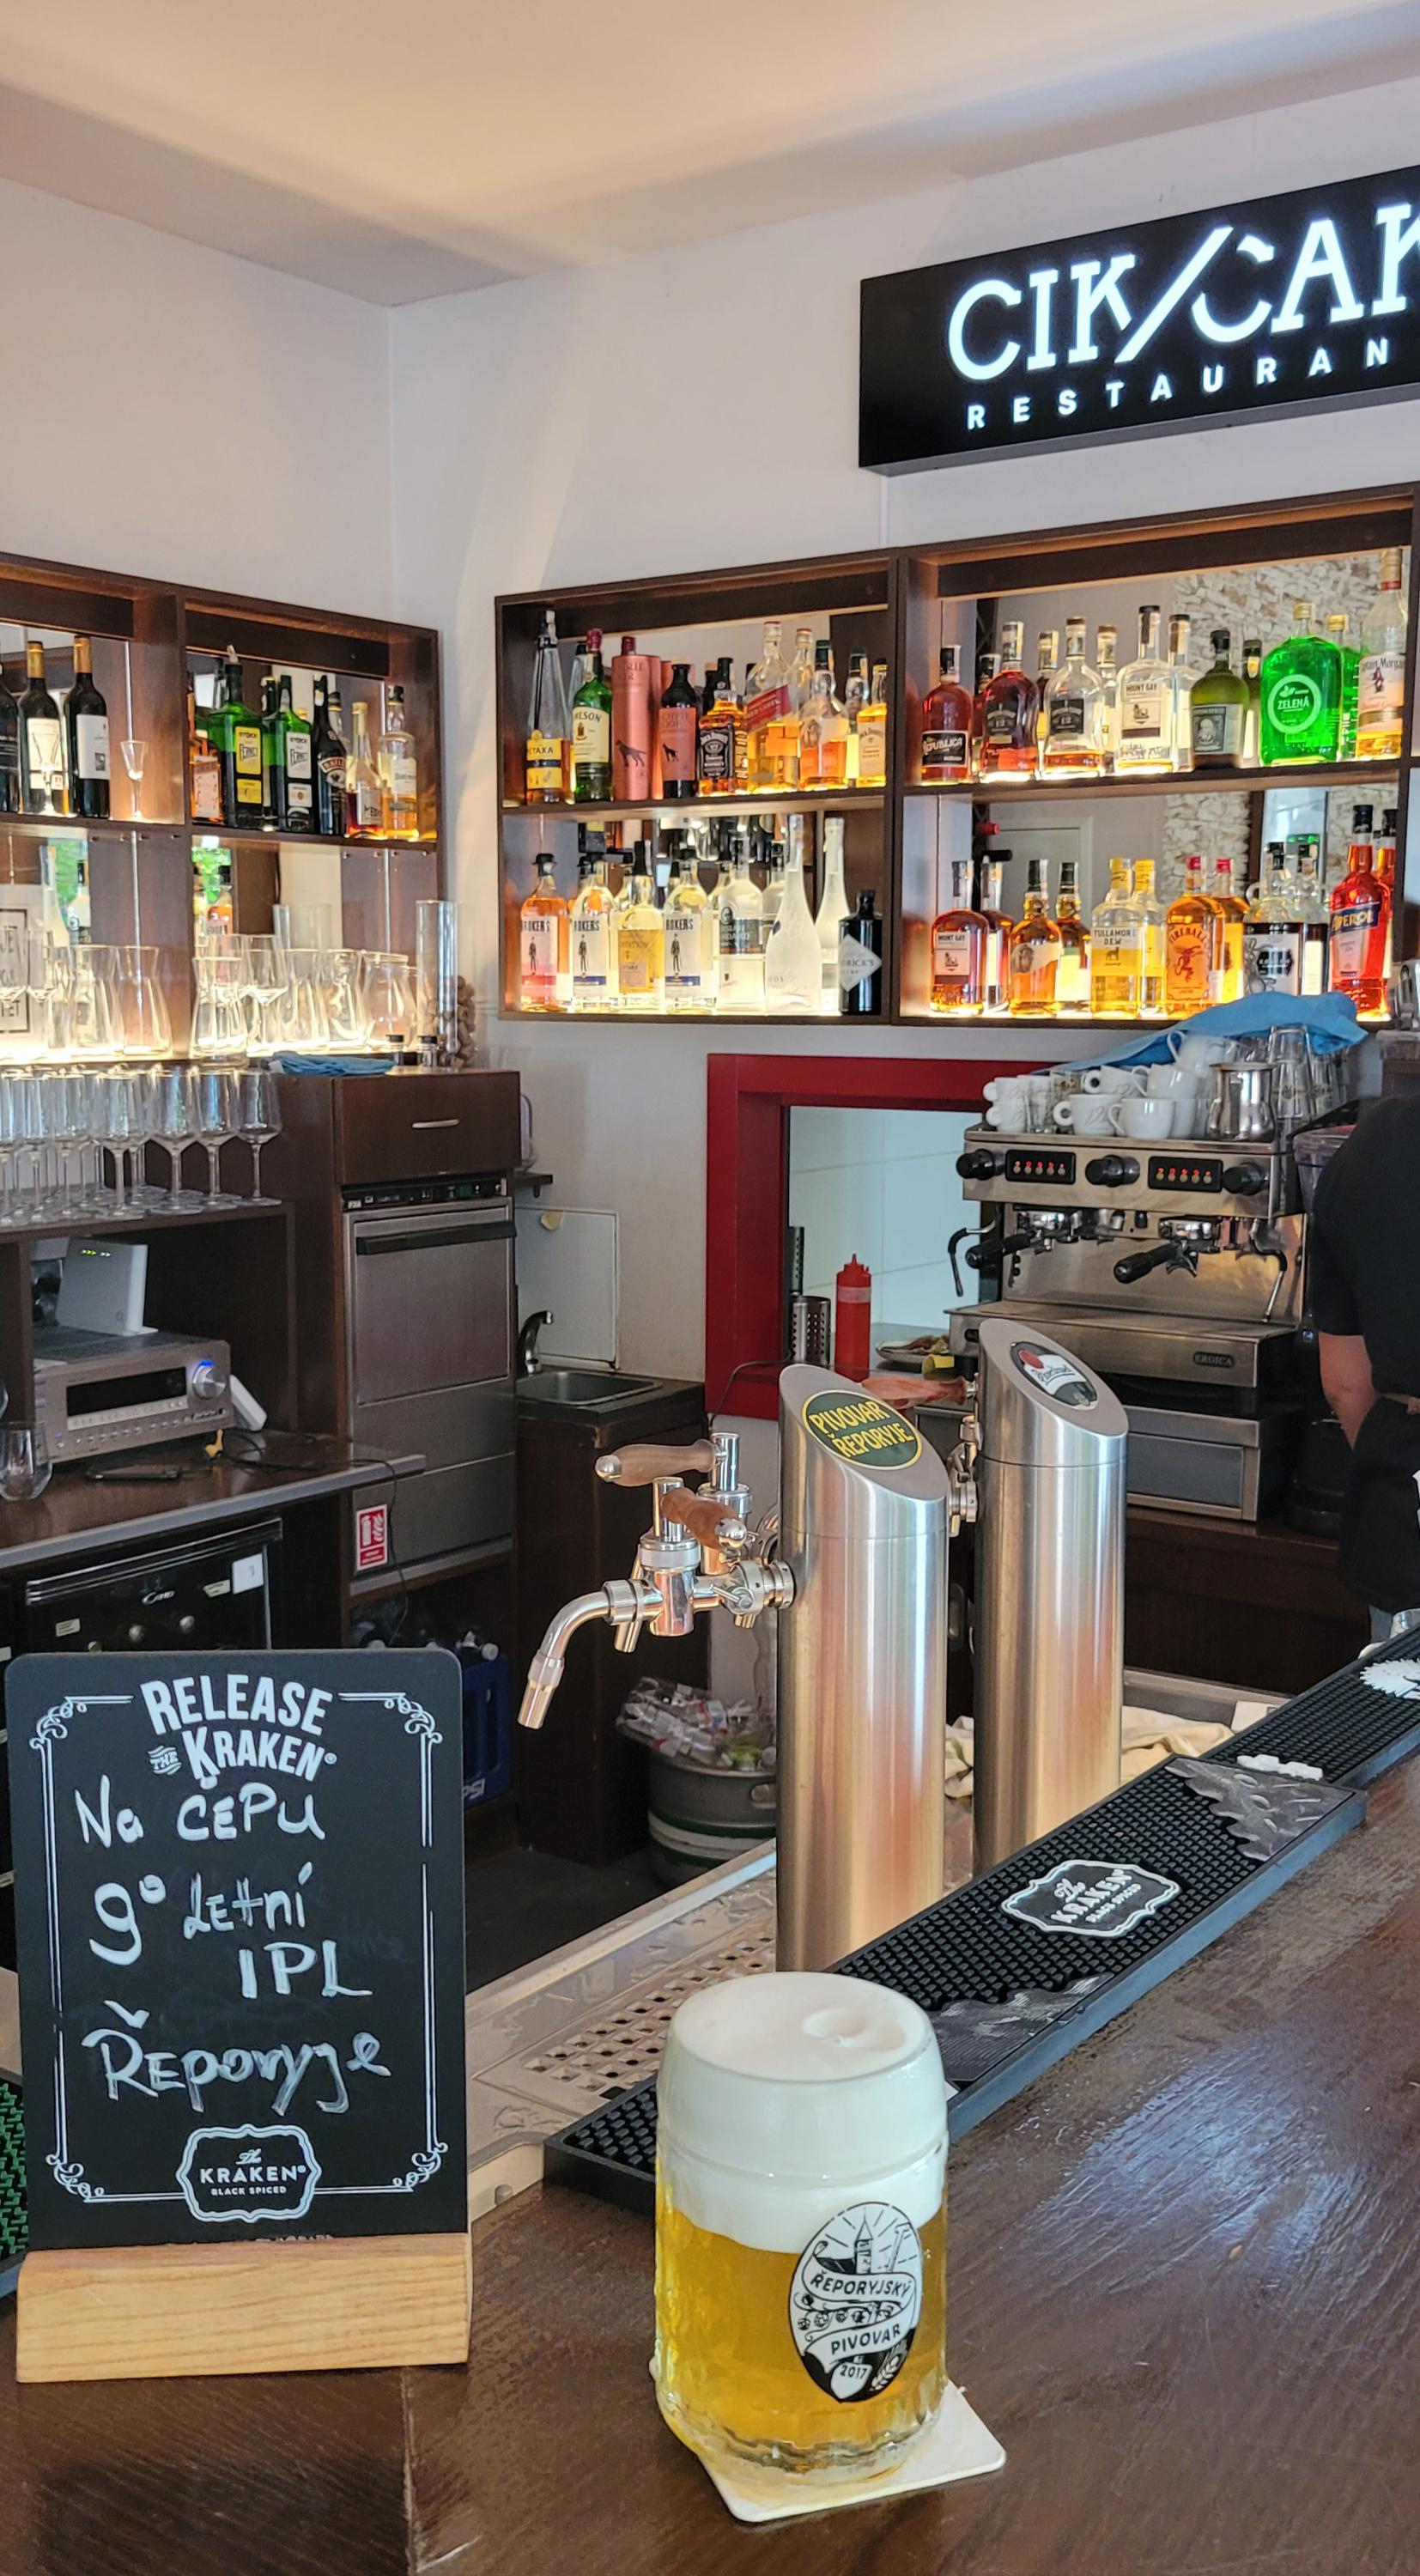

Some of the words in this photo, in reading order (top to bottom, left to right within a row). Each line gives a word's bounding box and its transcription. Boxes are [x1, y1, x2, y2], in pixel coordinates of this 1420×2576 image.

[1277, 696, 1310, 711] ZELENÁ
[1332, 910, 1374, 930] APEROL
[808, 1400, 891, 1435] PIVOVAR
[828, 1422, 915, 1458] ŘEPORYJE
[140, 1673, 335, 1735] RELEASE
[75, 1774, 144, 1848] Na
[1050, 1868, 1133, 1924] KRAKEN
[239, 1939, 373, 1999] IPL
[210, 2187, 246, 2196] BLACK
[249, 2185, 287, 2195] SPICED
[810, 2270, 913, 2298] ŘEPORYJSKÝ
[831, 2323, 901, 2355] PIVOVAR
[840, 2364, 867, 2380] 2017
